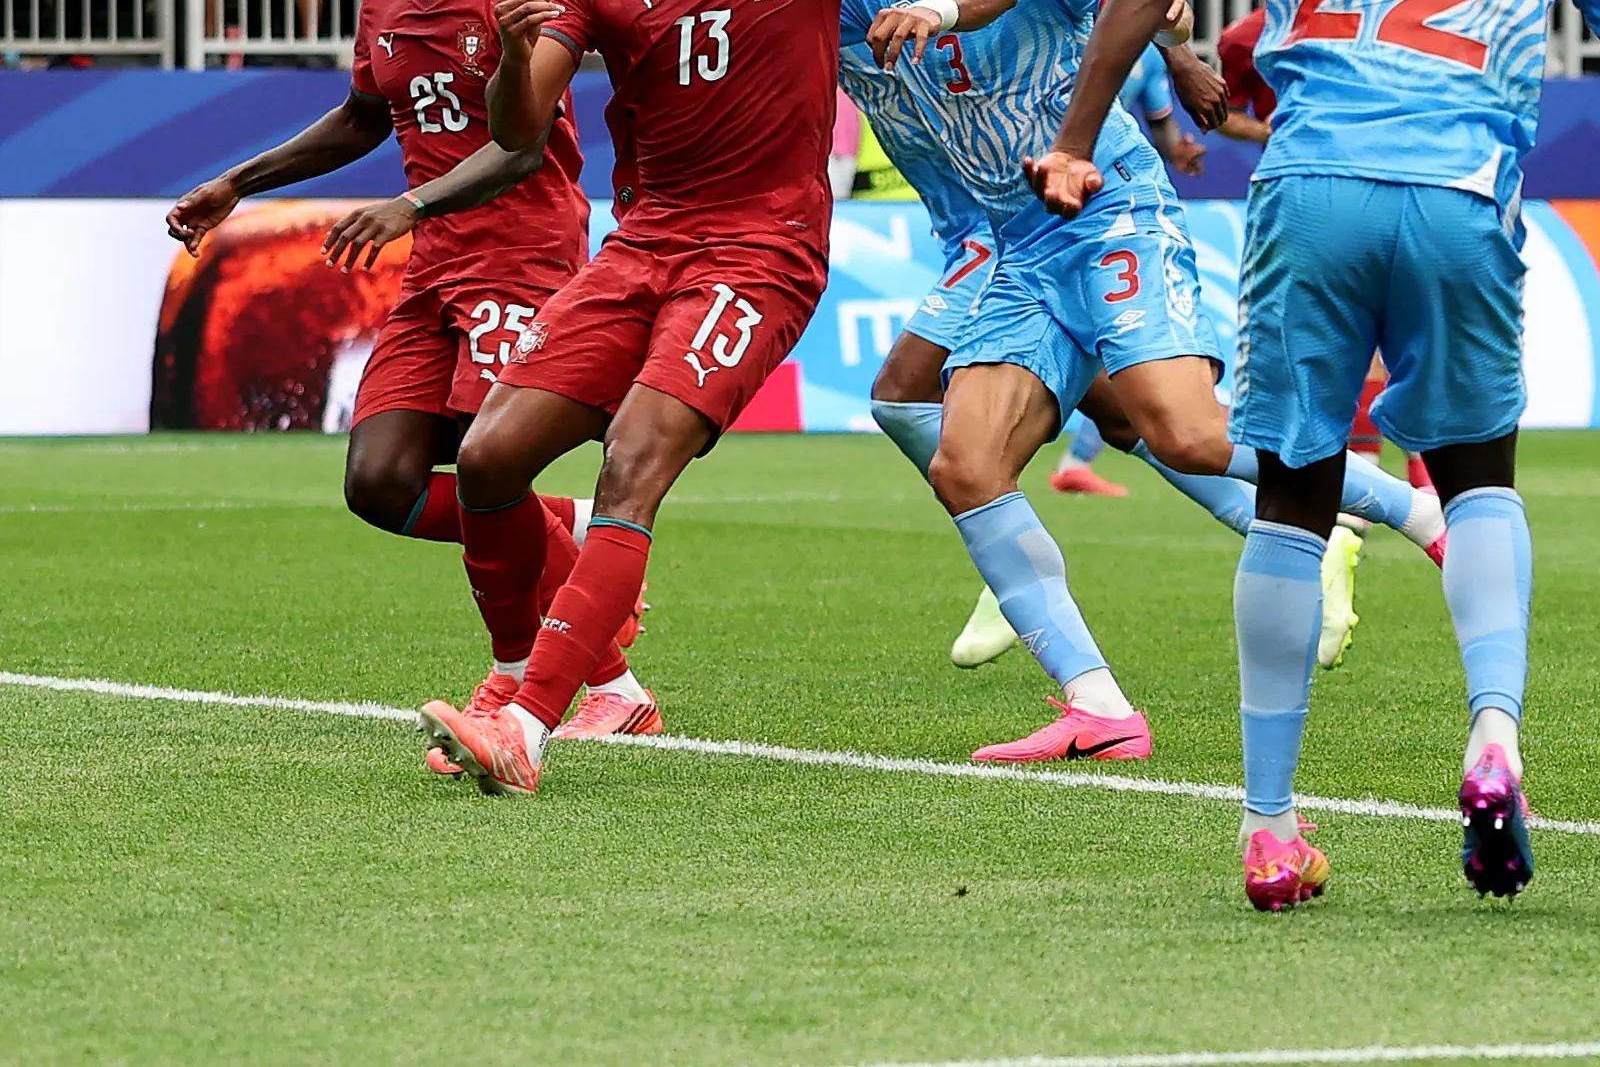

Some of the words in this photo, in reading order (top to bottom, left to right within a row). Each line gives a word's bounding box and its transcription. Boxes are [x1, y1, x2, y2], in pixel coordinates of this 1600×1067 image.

[673, 8, 732, 86] 13
[935, 33, 973, 94] 3
[409, 71, 469, 133] 25
[942, 239, 992, 290] 7
[1099, 248, 1141, 304] 3
[468, 299, 535, 367] 25
[690, 282, 763, 368] 13
